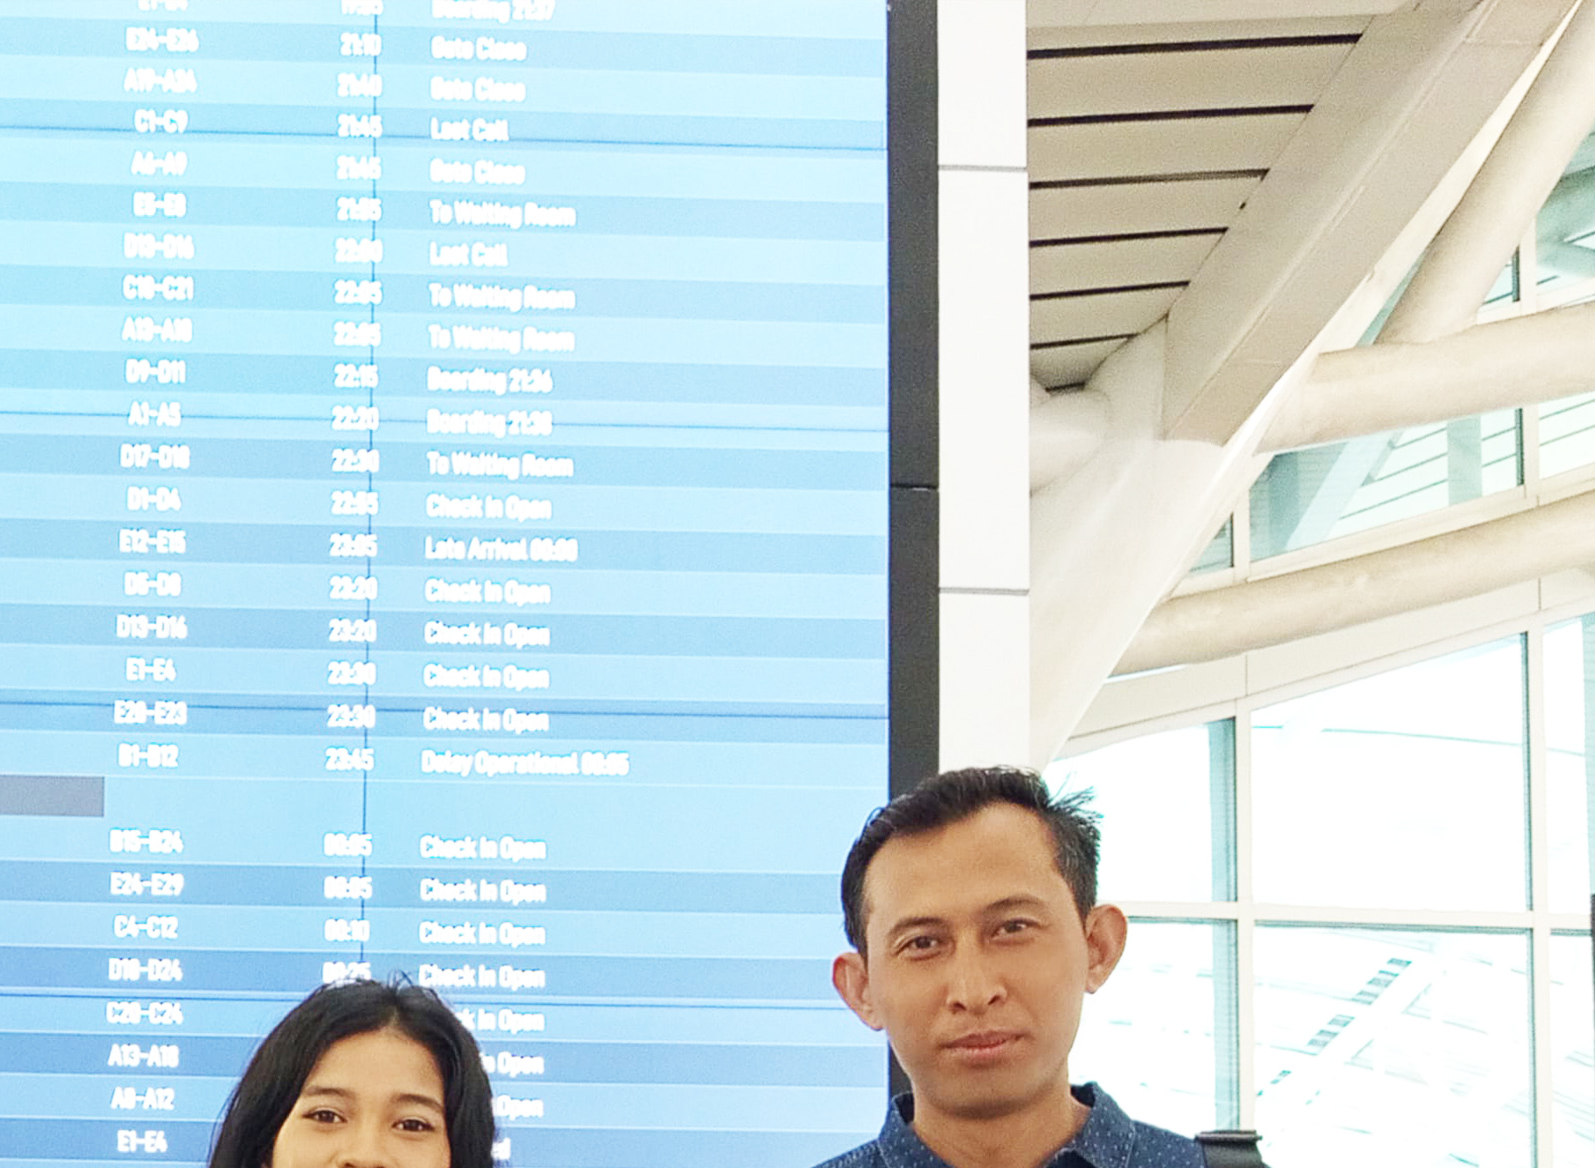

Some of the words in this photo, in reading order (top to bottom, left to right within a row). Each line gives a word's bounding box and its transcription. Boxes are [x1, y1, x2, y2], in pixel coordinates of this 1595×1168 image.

[430, 201, 453, 224] To
[429, 284, 453, 307] To
[428, 325, 452, 349] To
[427, 452, 450, 476] To
[426, 495, 484, 519] Check
[505, 496, 553, 523] Open
[425, 580, 483, 603] Check
[504, 581, 552, 607] Open
[329, 620, 378, 643] 23:20
[425, 622, 482, 645] Check
[504, 624, 551, 650] Open
[126, 659, 177, 682] E1-E4
[328, 662, 377, 686] 23:30
[424, 665, 482, 688] Check
[503, 666, 550, 692] Open
[328, 705, 377, 729] 23:30
[424, 707, 481, 731] Check
[503, 709, 550, 735] Open
[420, 836, 478, 859] Check
[500, 837, 547, 863] Open
[420, 879, 478, 902] Check
[500, 881, 547, 906] Open
[114, 916, 179, 939] C4-C12
[419, 922, 477, 945] Check
[499, 923, 547, 949] Open
[419, 965, 476, 988] Check
[499, 966, 546, 992] Open
[498, 1010, 546, 1035] Open
[497, 1052, 545, 1078] Open
[494, 1096, 545, 1121] Open
[118, 1131, 168, 1153] E1-E4
